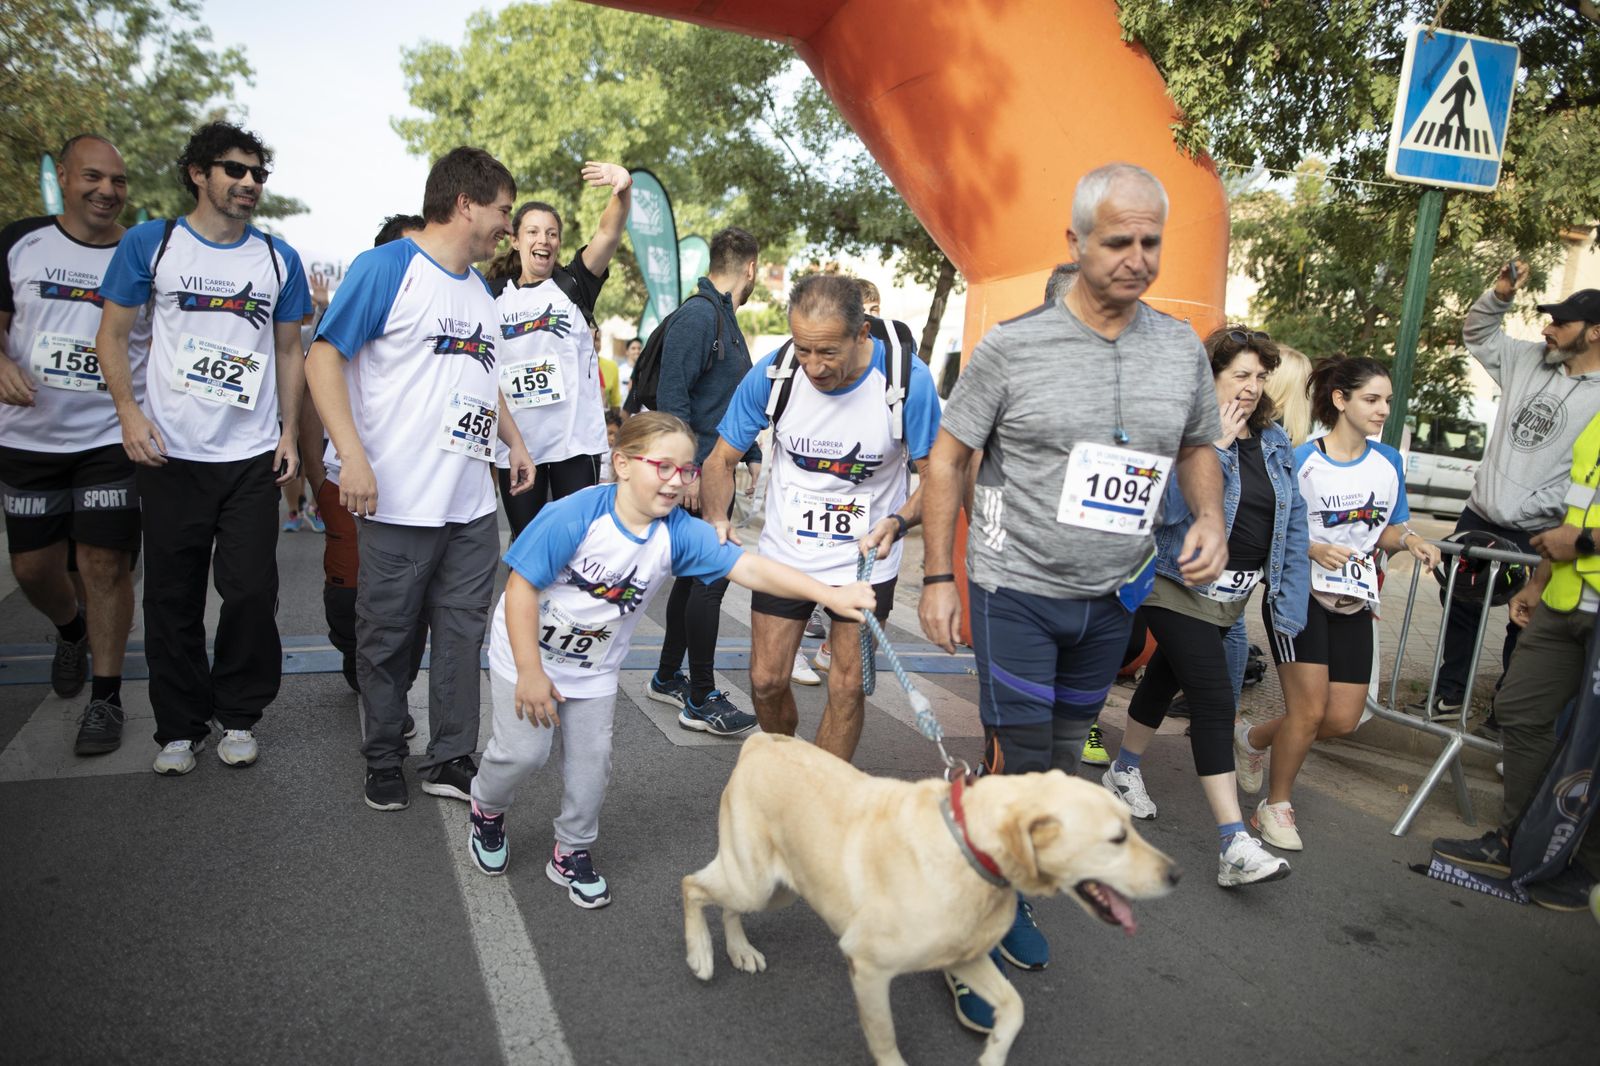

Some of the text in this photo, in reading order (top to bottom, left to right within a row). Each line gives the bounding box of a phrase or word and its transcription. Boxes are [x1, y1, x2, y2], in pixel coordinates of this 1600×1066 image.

[45, 267, 99, 281] VII CARRERA
[311, 259, 345, 282] caj
[68, 278, 98, 286] MARCHA
[180, 275, 235, 290] VII CARRERA
[205, 286, 235, 294] MARCHA
[184, 296, 257, 311] ASPACE
[438, 318, 454, 333] VII
[503, 312, 518, 323] VII
[506, 316, 558, 335] ASPACE
[51, 350, 99, 374] 158
[193, 356, 244, 385] 462
[512, 373, 549, 393] 159
[458, 412, 492, 439] 458
[1517, 408, 1555, 436] VOLCOM
[789, 435, 843, 452] VII CARRERA
[797, 457, 865, 474] ASPACE
[83, 489, 127, 508] SPORT
[1087, 473, 1152, 506] 1094
[1321, 495, 1341, 508] VII
[803, 510, 851, 534] 118
[1327, 508, 1379, 524] ASPACE
[583, 557, 606, 581] VII
[1231, 571, 1255, 589] 97
[542, 625, 593, 653] 119
